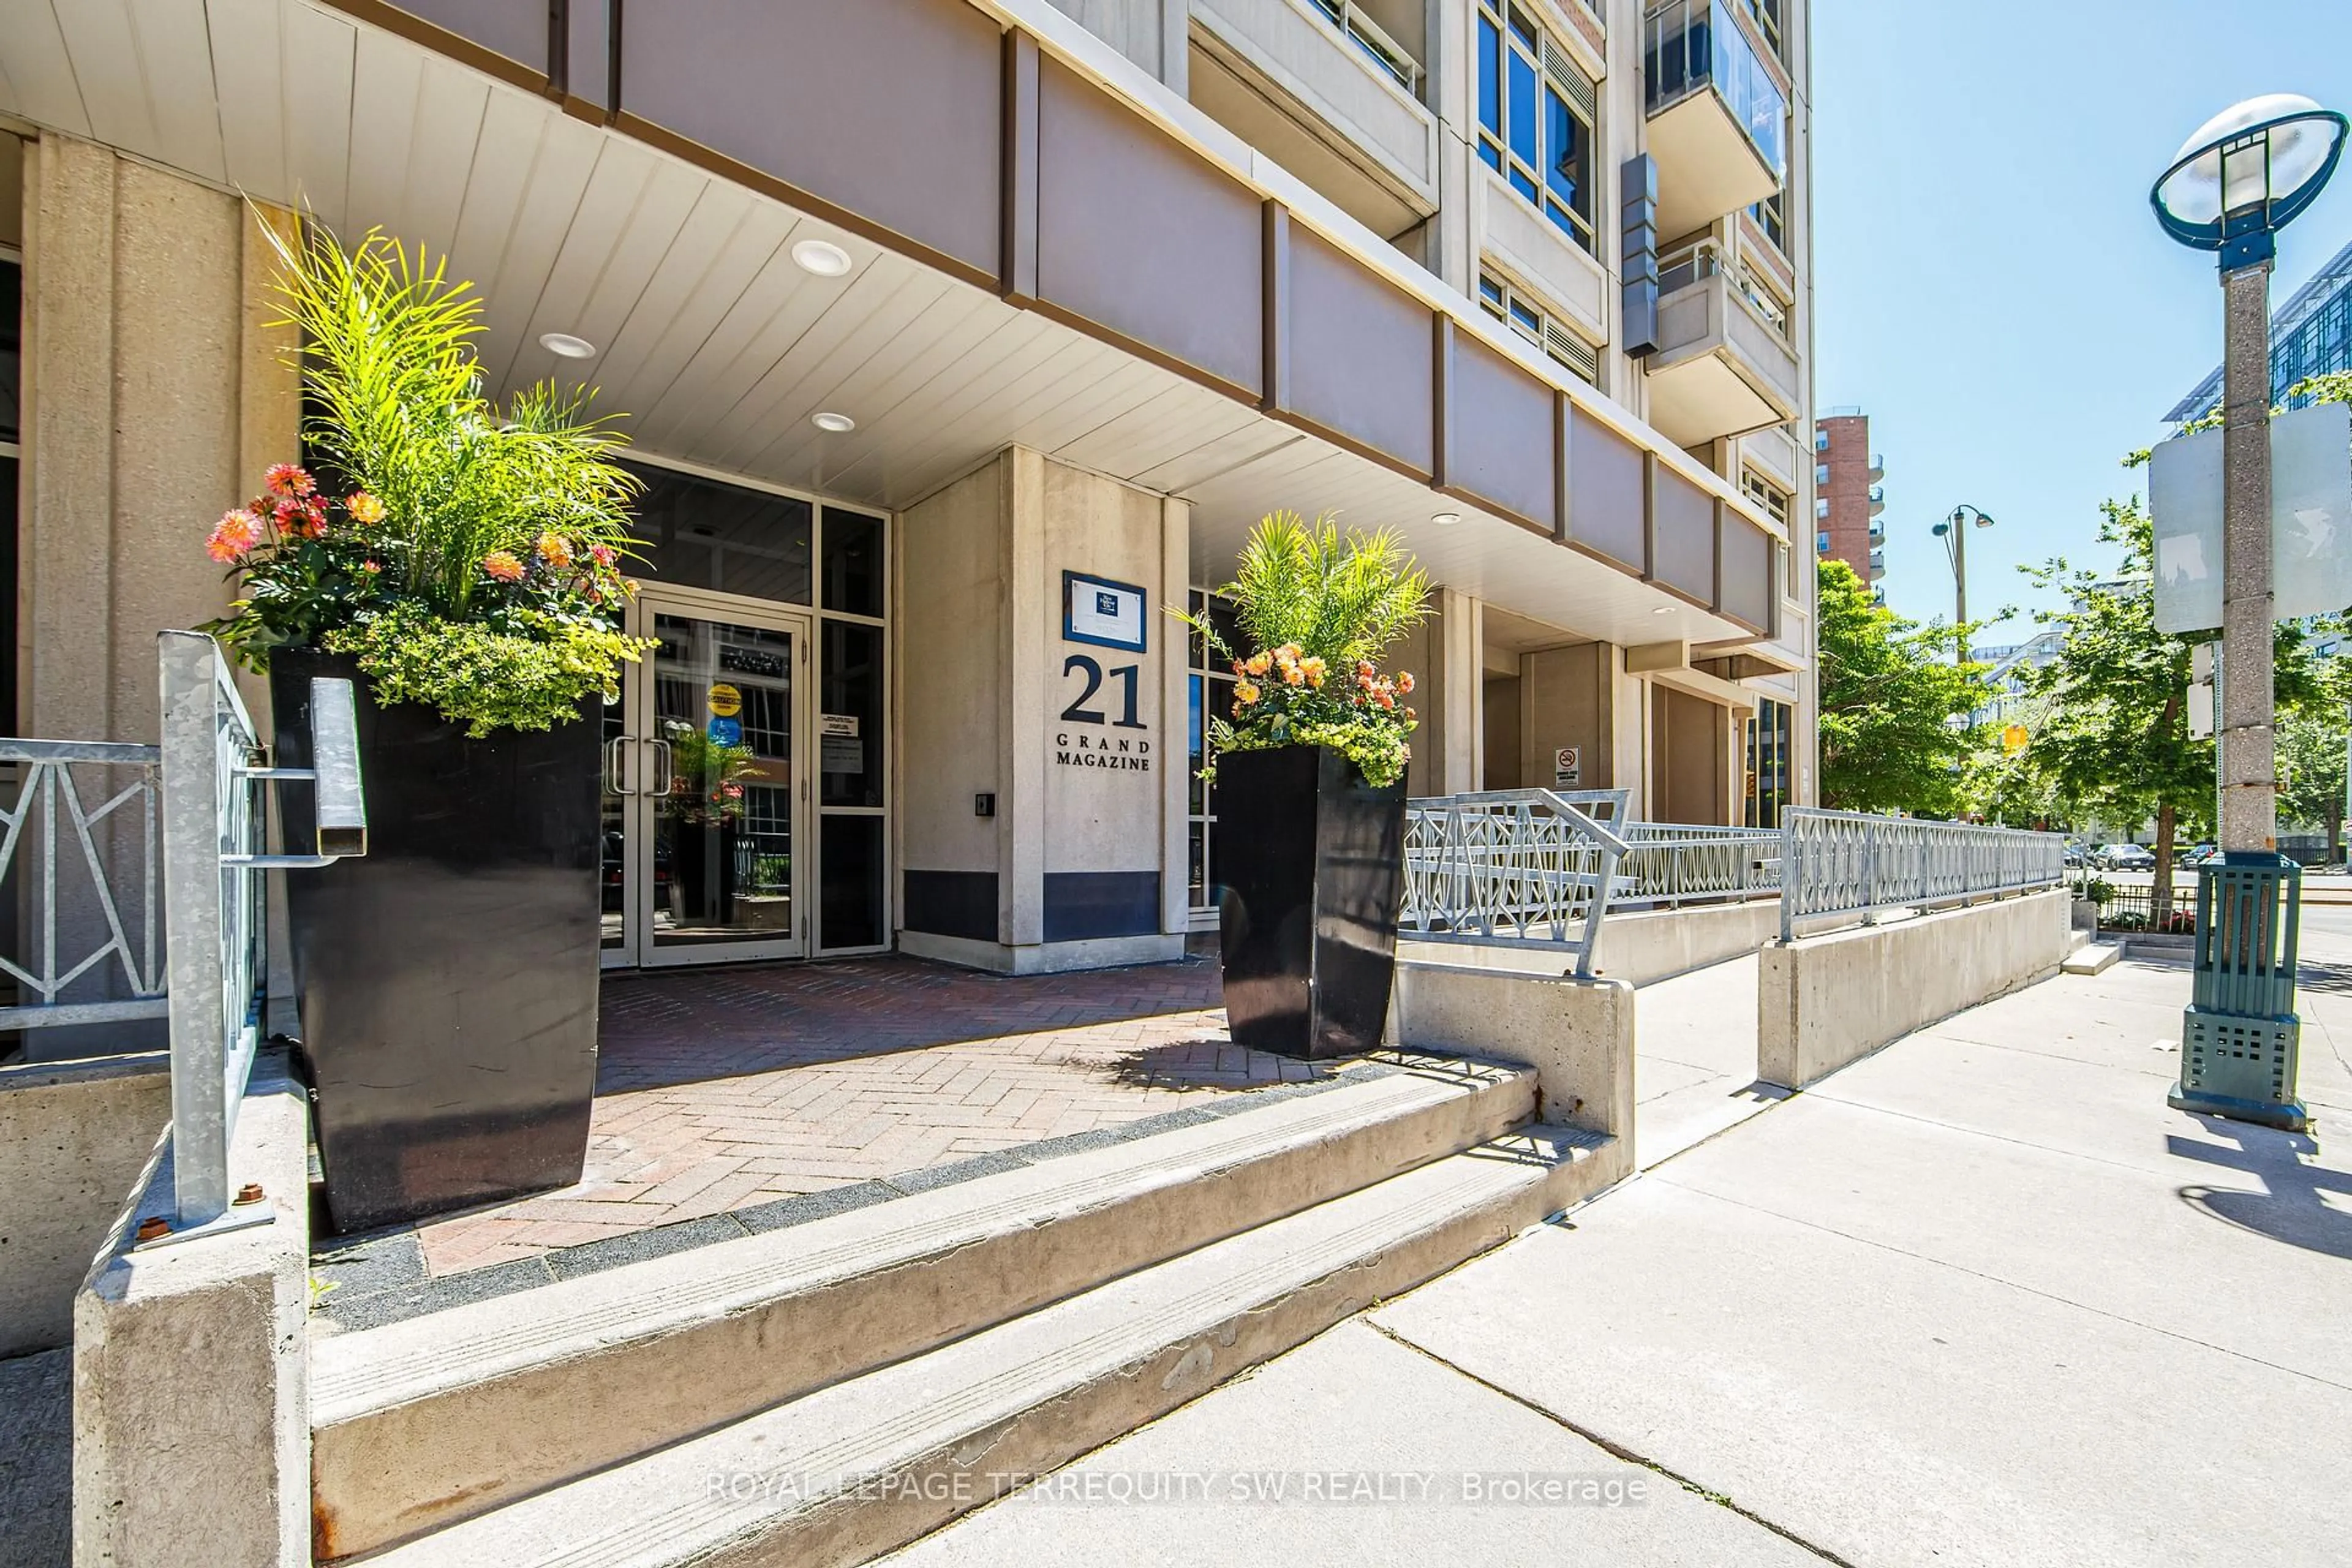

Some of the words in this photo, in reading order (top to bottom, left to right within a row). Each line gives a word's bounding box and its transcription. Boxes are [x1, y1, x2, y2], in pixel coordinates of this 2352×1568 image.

[1061, 654, 1147, 729] 21
[1057, 733, 1149, 753] GRAND
[1057, 751, 1149, 771] MAGAZINE
